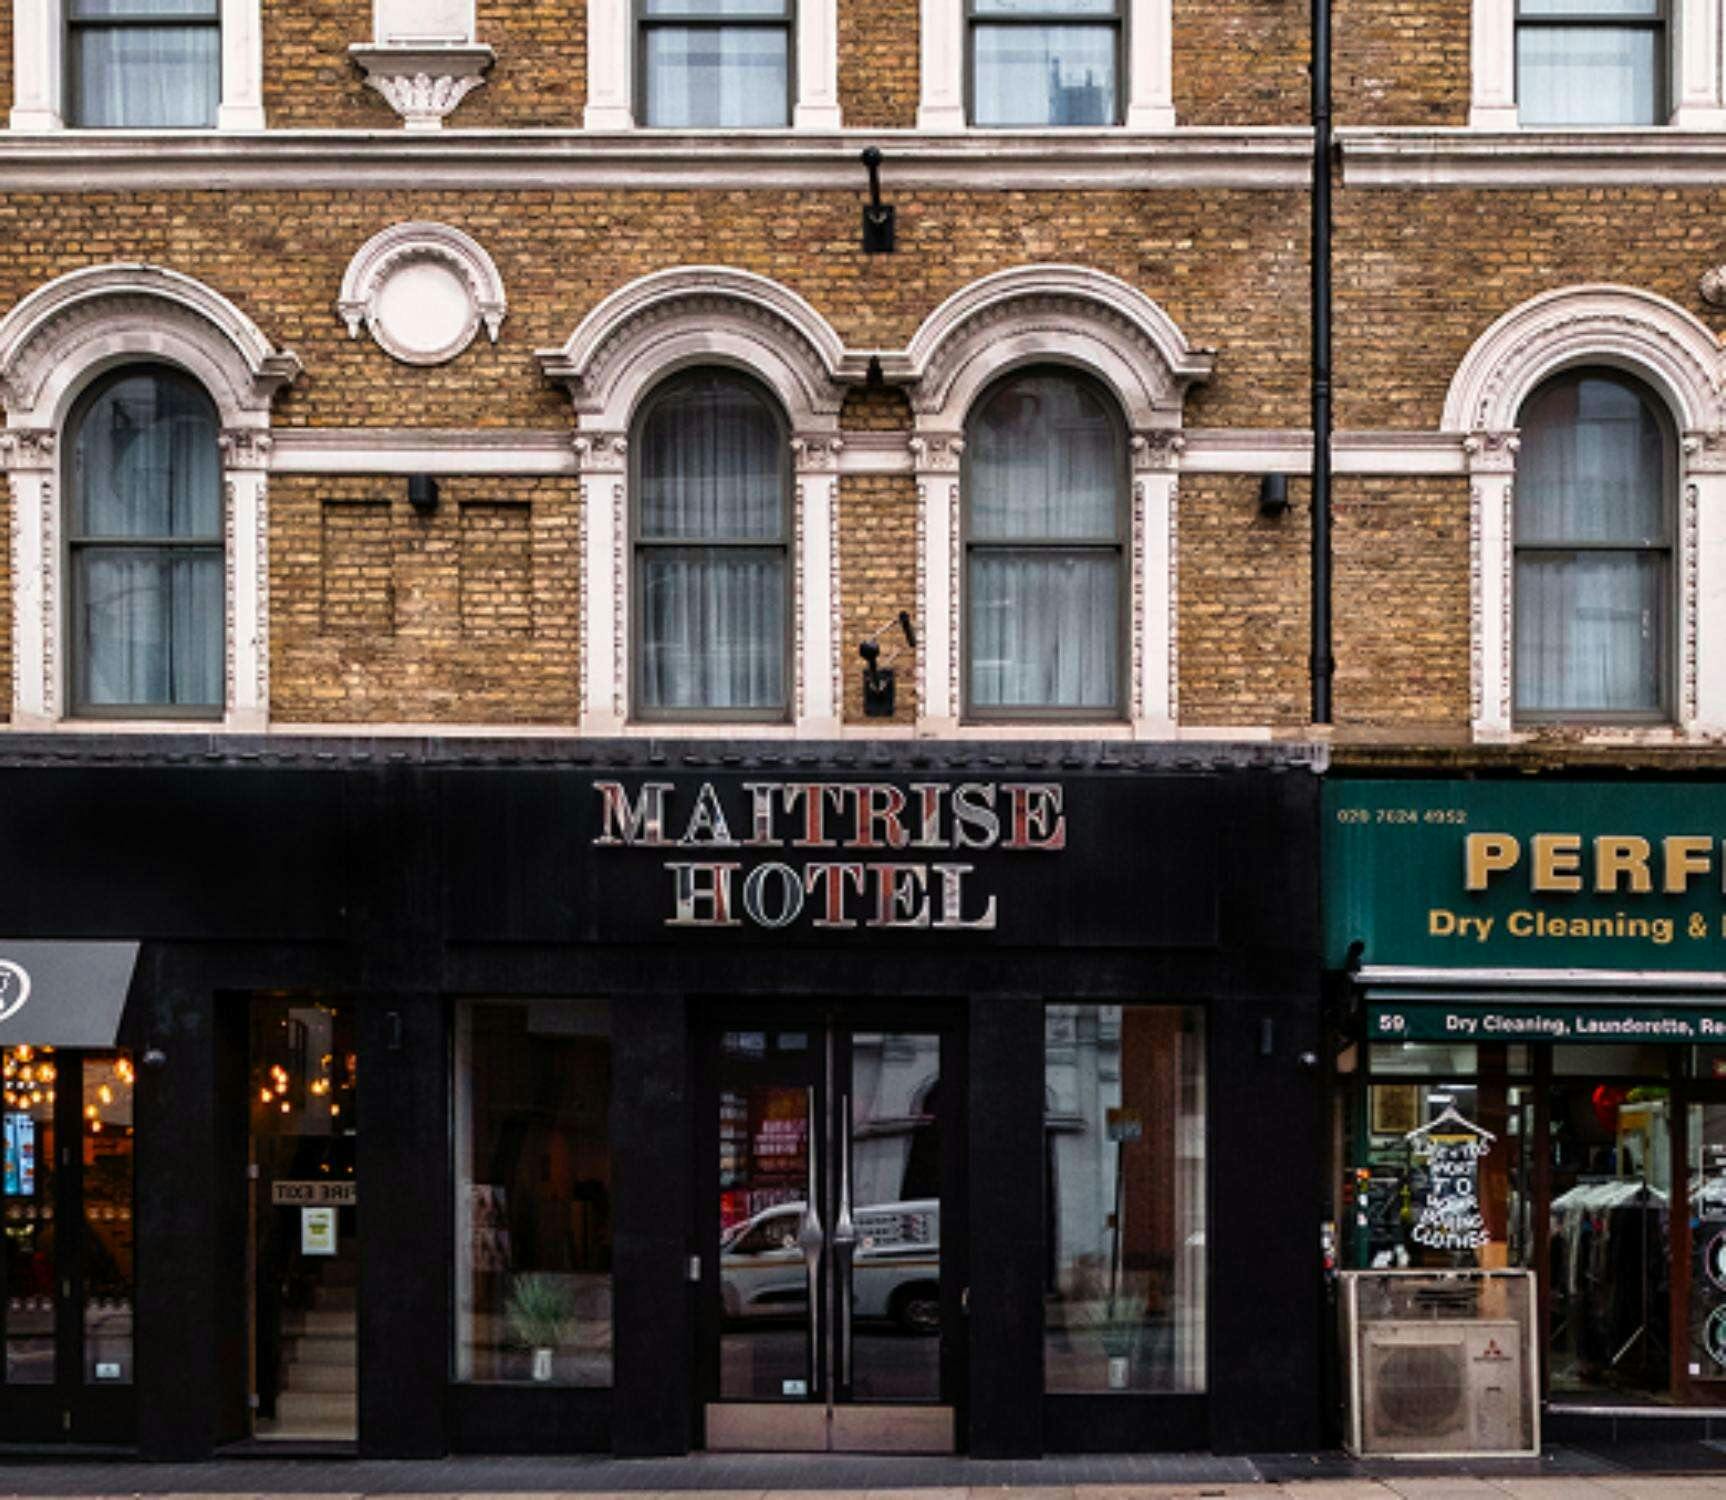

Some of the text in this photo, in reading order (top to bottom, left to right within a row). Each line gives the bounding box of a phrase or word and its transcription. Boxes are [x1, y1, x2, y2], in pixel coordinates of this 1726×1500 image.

[593, 780, 1066, 849] MAITRISE
[1465, 832, 1726, 893] PERF
[664, 861, 997, 928] HOTEL
[1429, 909, 1494, 943] Dry
[1507, 909, 1674, 944] Cleaning
[1688, 911, 1707, 938] &
[1446, 1014, 1478, 1034] Dry
[1483, 1014, 1571, 1036] Cleaning,
